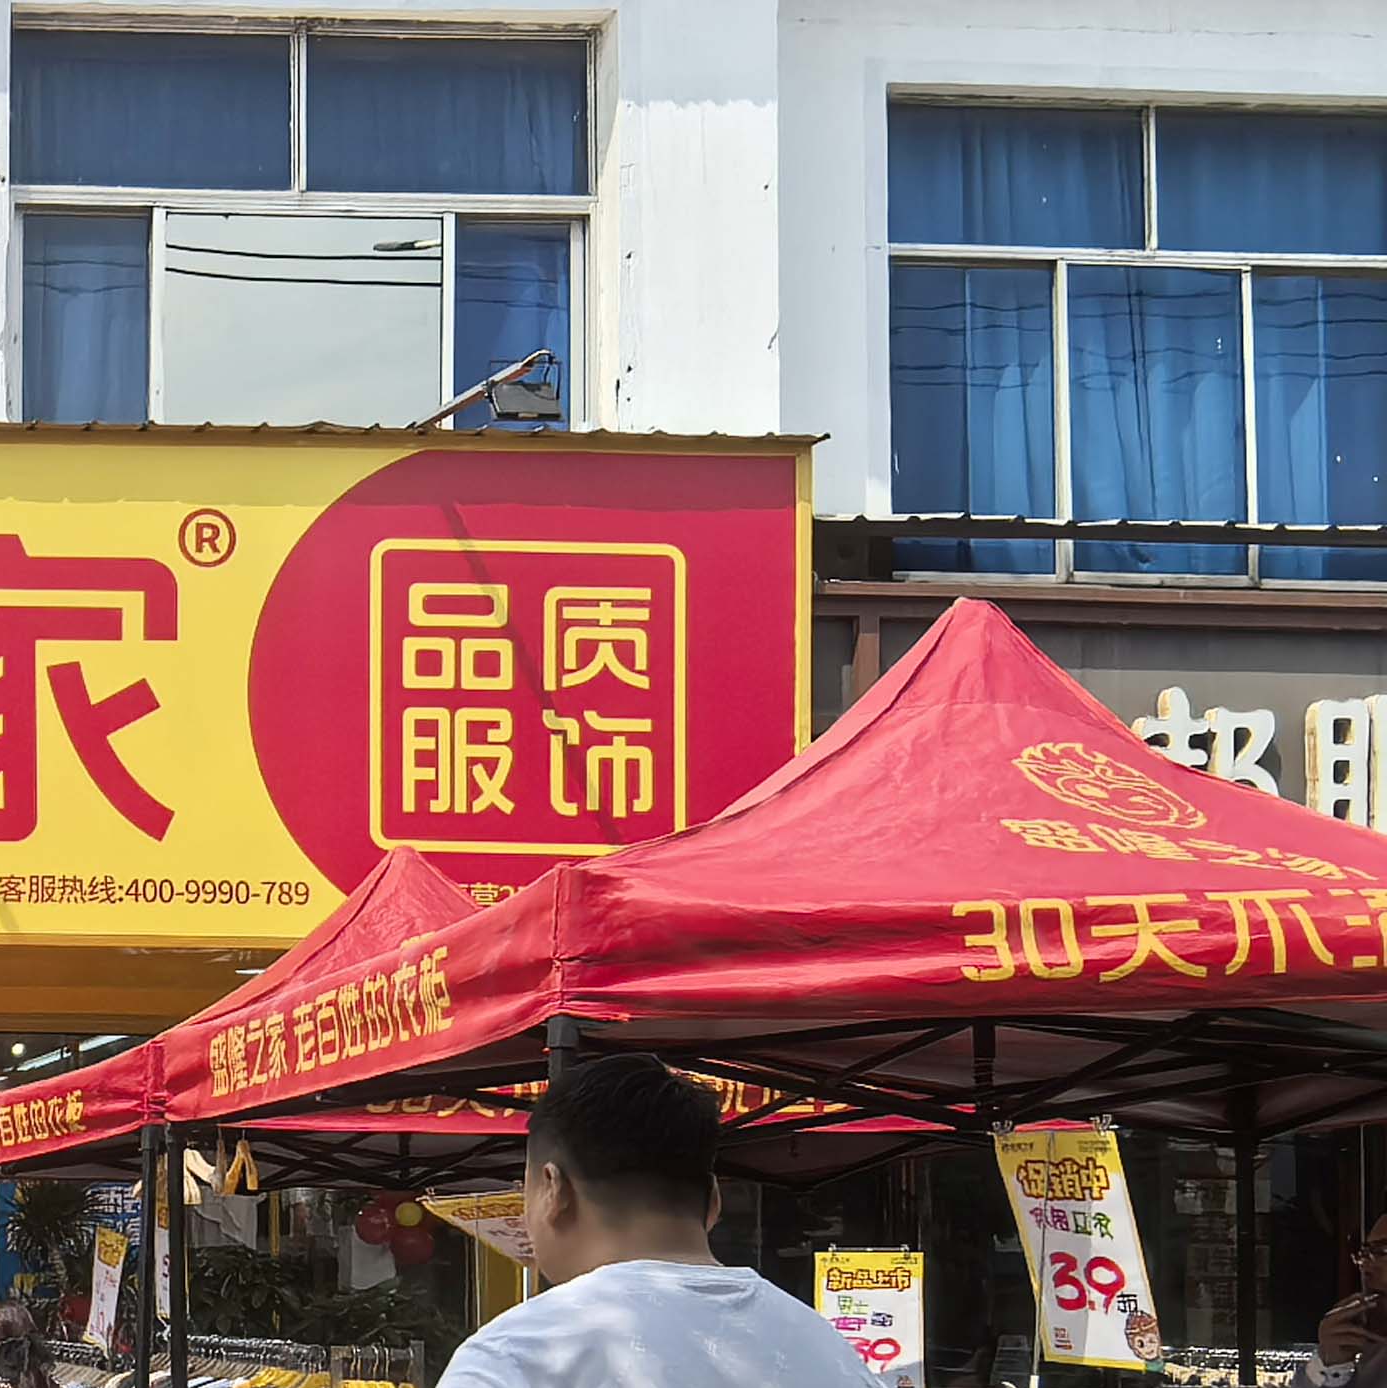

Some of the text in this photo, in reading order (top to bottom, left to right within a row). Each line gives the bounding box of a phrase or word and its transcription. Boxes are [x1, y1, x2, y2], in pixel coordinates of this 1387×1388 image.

[401, 582, 652, 691] 品质
[401, 706, 653, 818] 服饰
[826, 1266, 911, 1292] 新品上市
